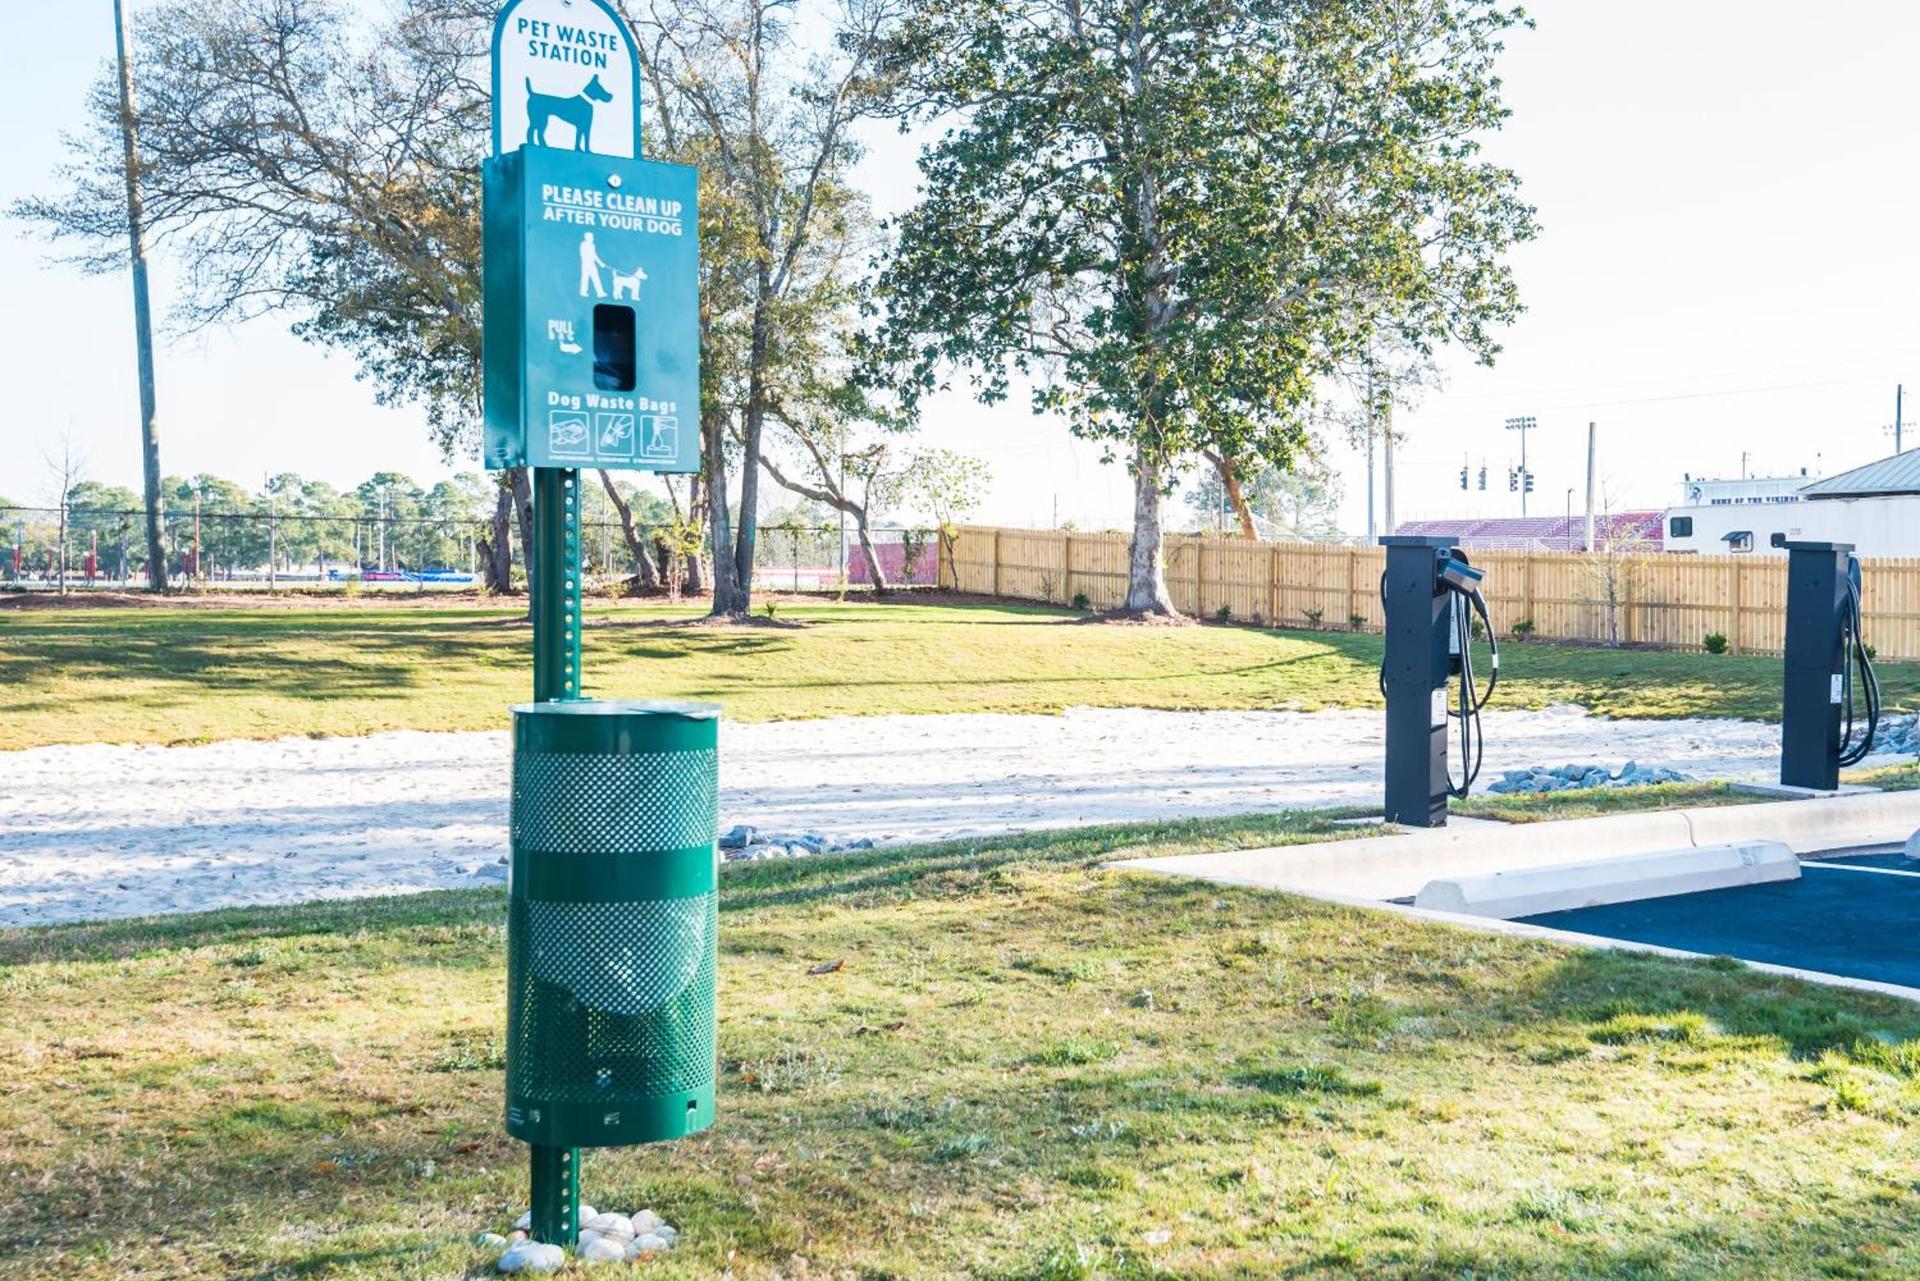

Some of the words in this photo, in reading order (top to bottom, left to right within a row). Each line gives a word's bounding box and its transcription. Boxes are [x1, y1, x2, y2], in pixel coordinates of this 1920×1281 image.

[518, 17, 551, 38] PET
[556, 25, 617, 51] WASTE
[529, 40, 607, 69] STATION
[542, 184, 602, 208] PLEASE
[606, 192, 657, 216] CLEAN
[661, 200, 682, 217] UP
[543, 206, 595, 226] AFTER
[600, 214, 643, 232] YOUR
[646, 221, 682, 236] DOG
[548, 319, 573, 334] PULL
[548, 391, 580, 409] Dog
[586, 393, 634, 410] Waste
[639, 397, 677, 414] Bags
